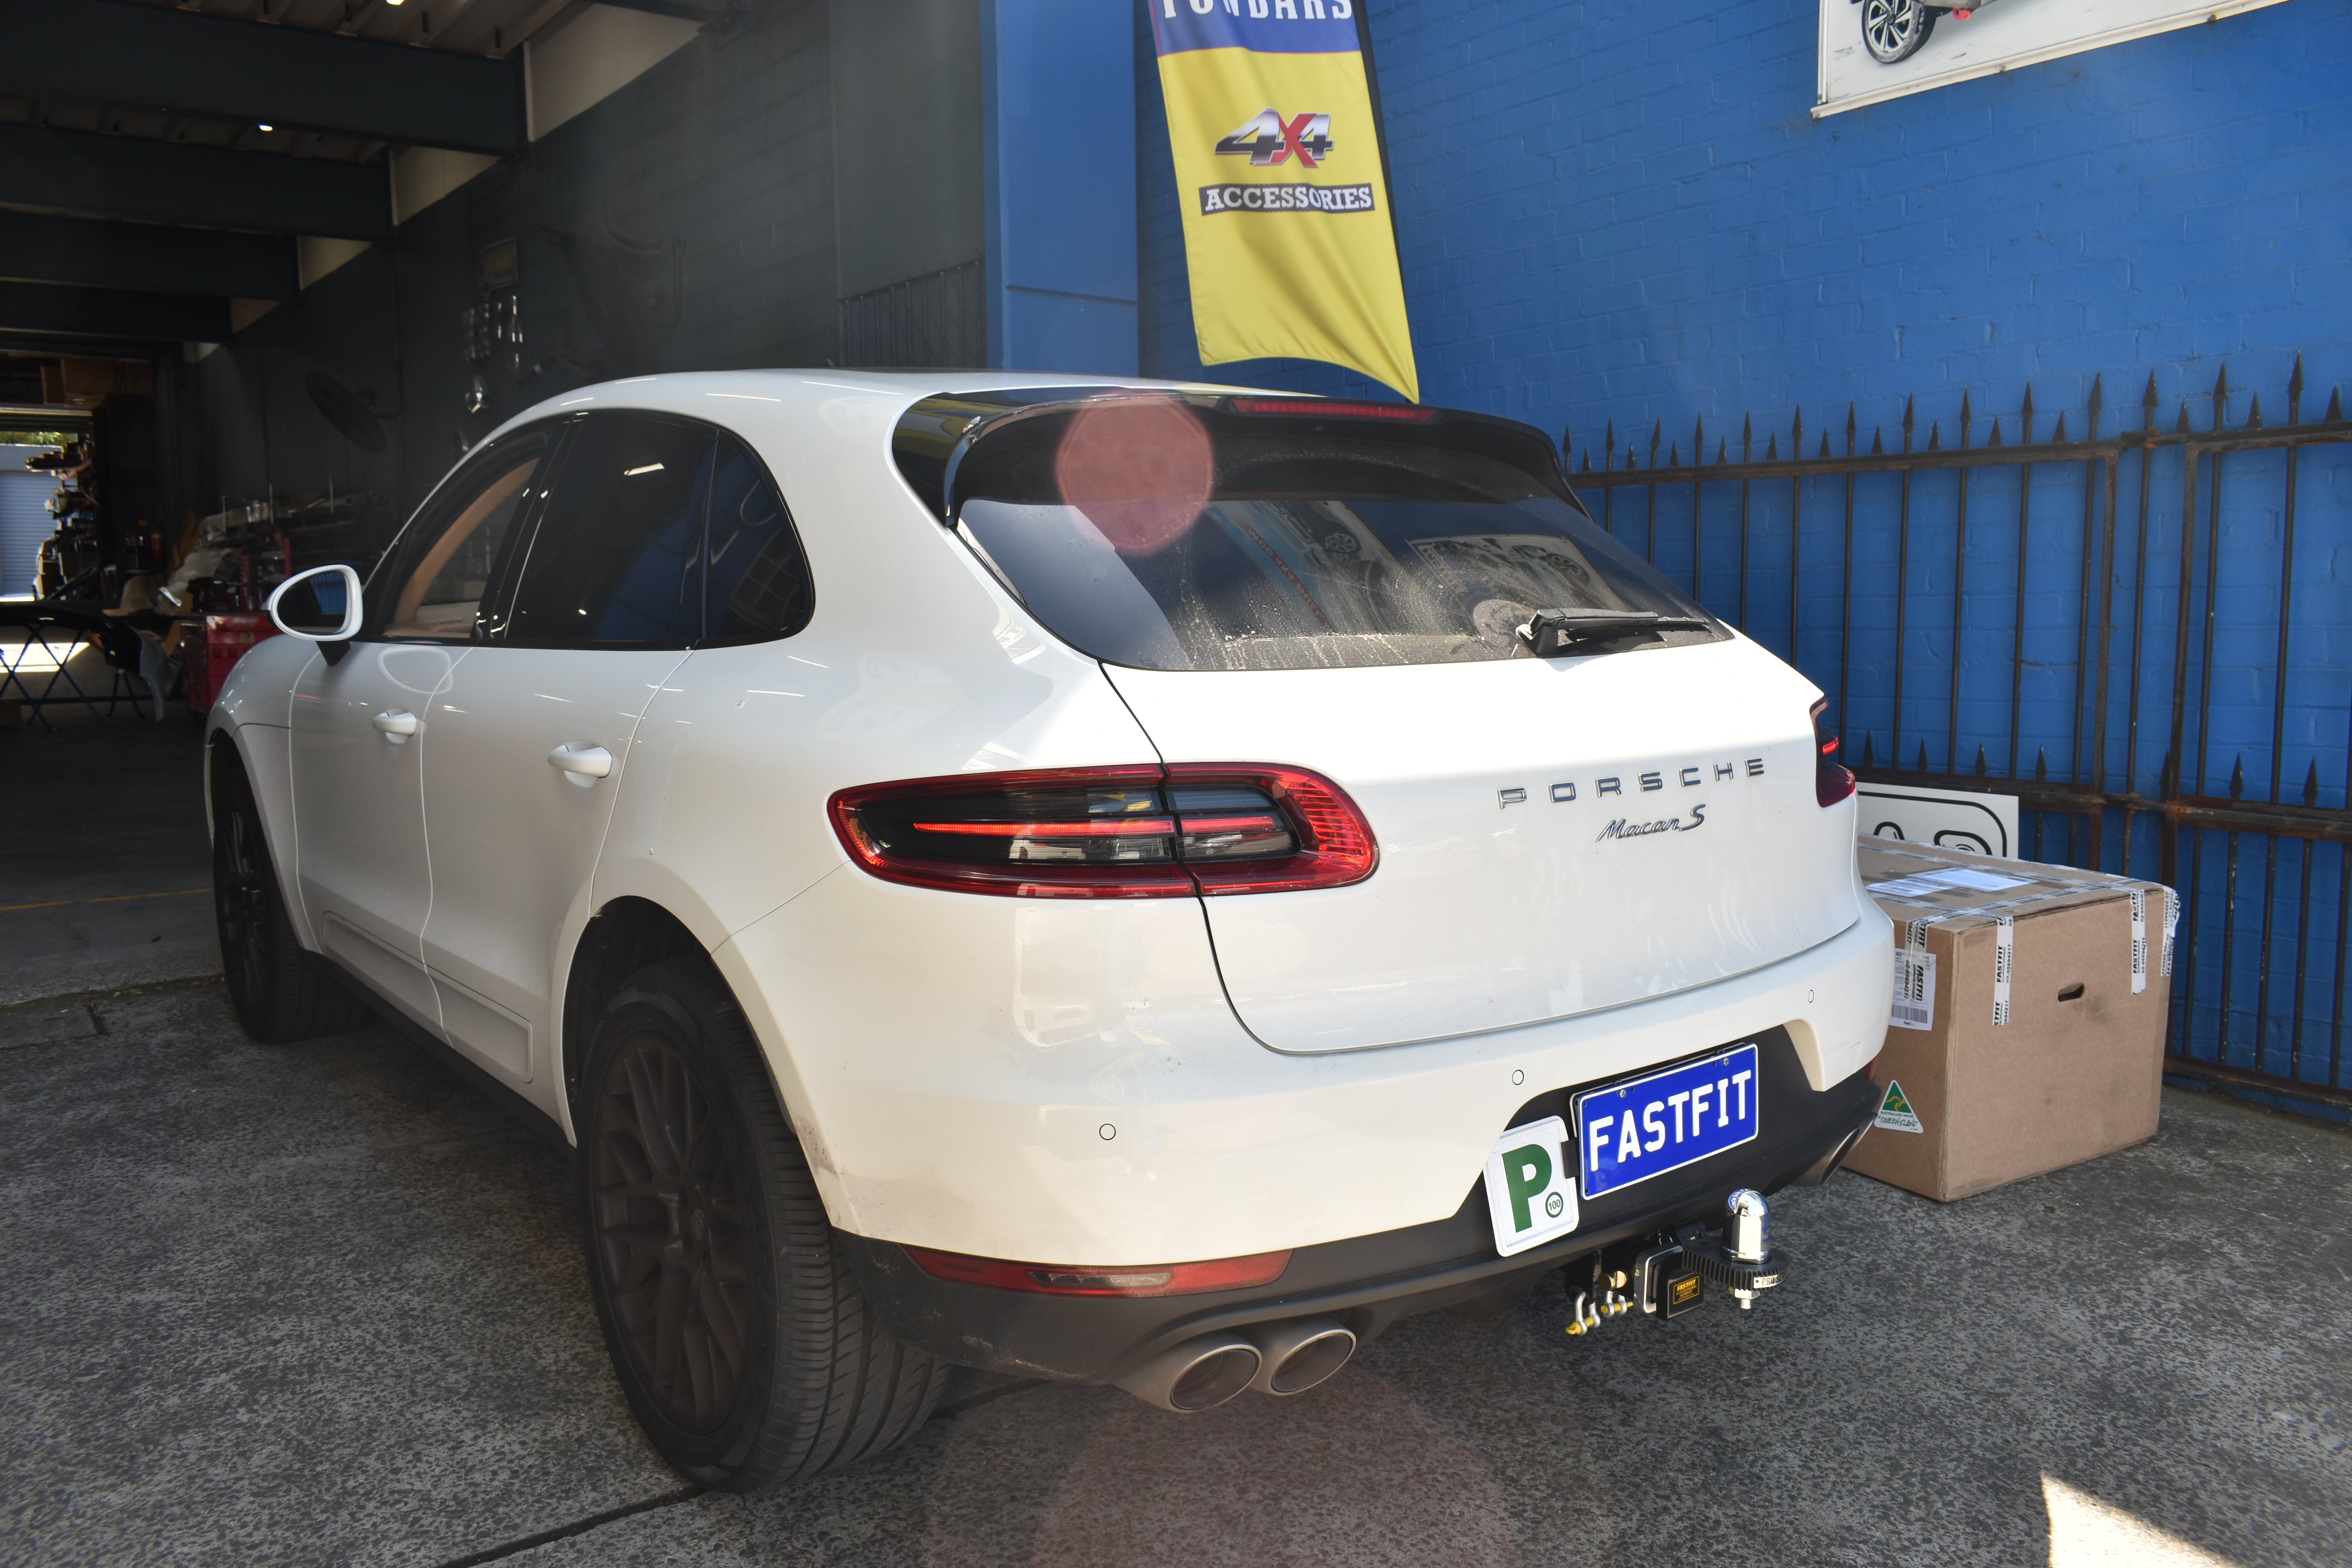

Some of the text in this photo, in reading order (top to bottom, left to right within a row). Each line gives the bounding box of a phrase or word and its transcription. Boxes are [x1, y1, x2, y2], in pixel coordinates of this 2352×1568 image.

[1205, 187, 1372, 211] ACCESSORIES
[1497, 758, 1764, 809] PORSCHE
[1595, 804, 1706, 842] Macan S
[1589, 1069, 1751, 1172] FASTFIT
[1880, 1117, 1918, 1127] QUEENSLAND
[1502, 1143, 1552, 1233] P
[1548, 1199, 1561, 1210] 100
[1677, 1279, 1696, 1292] FASTFIT
[1762, 1276, 1775, 1286] PRO
